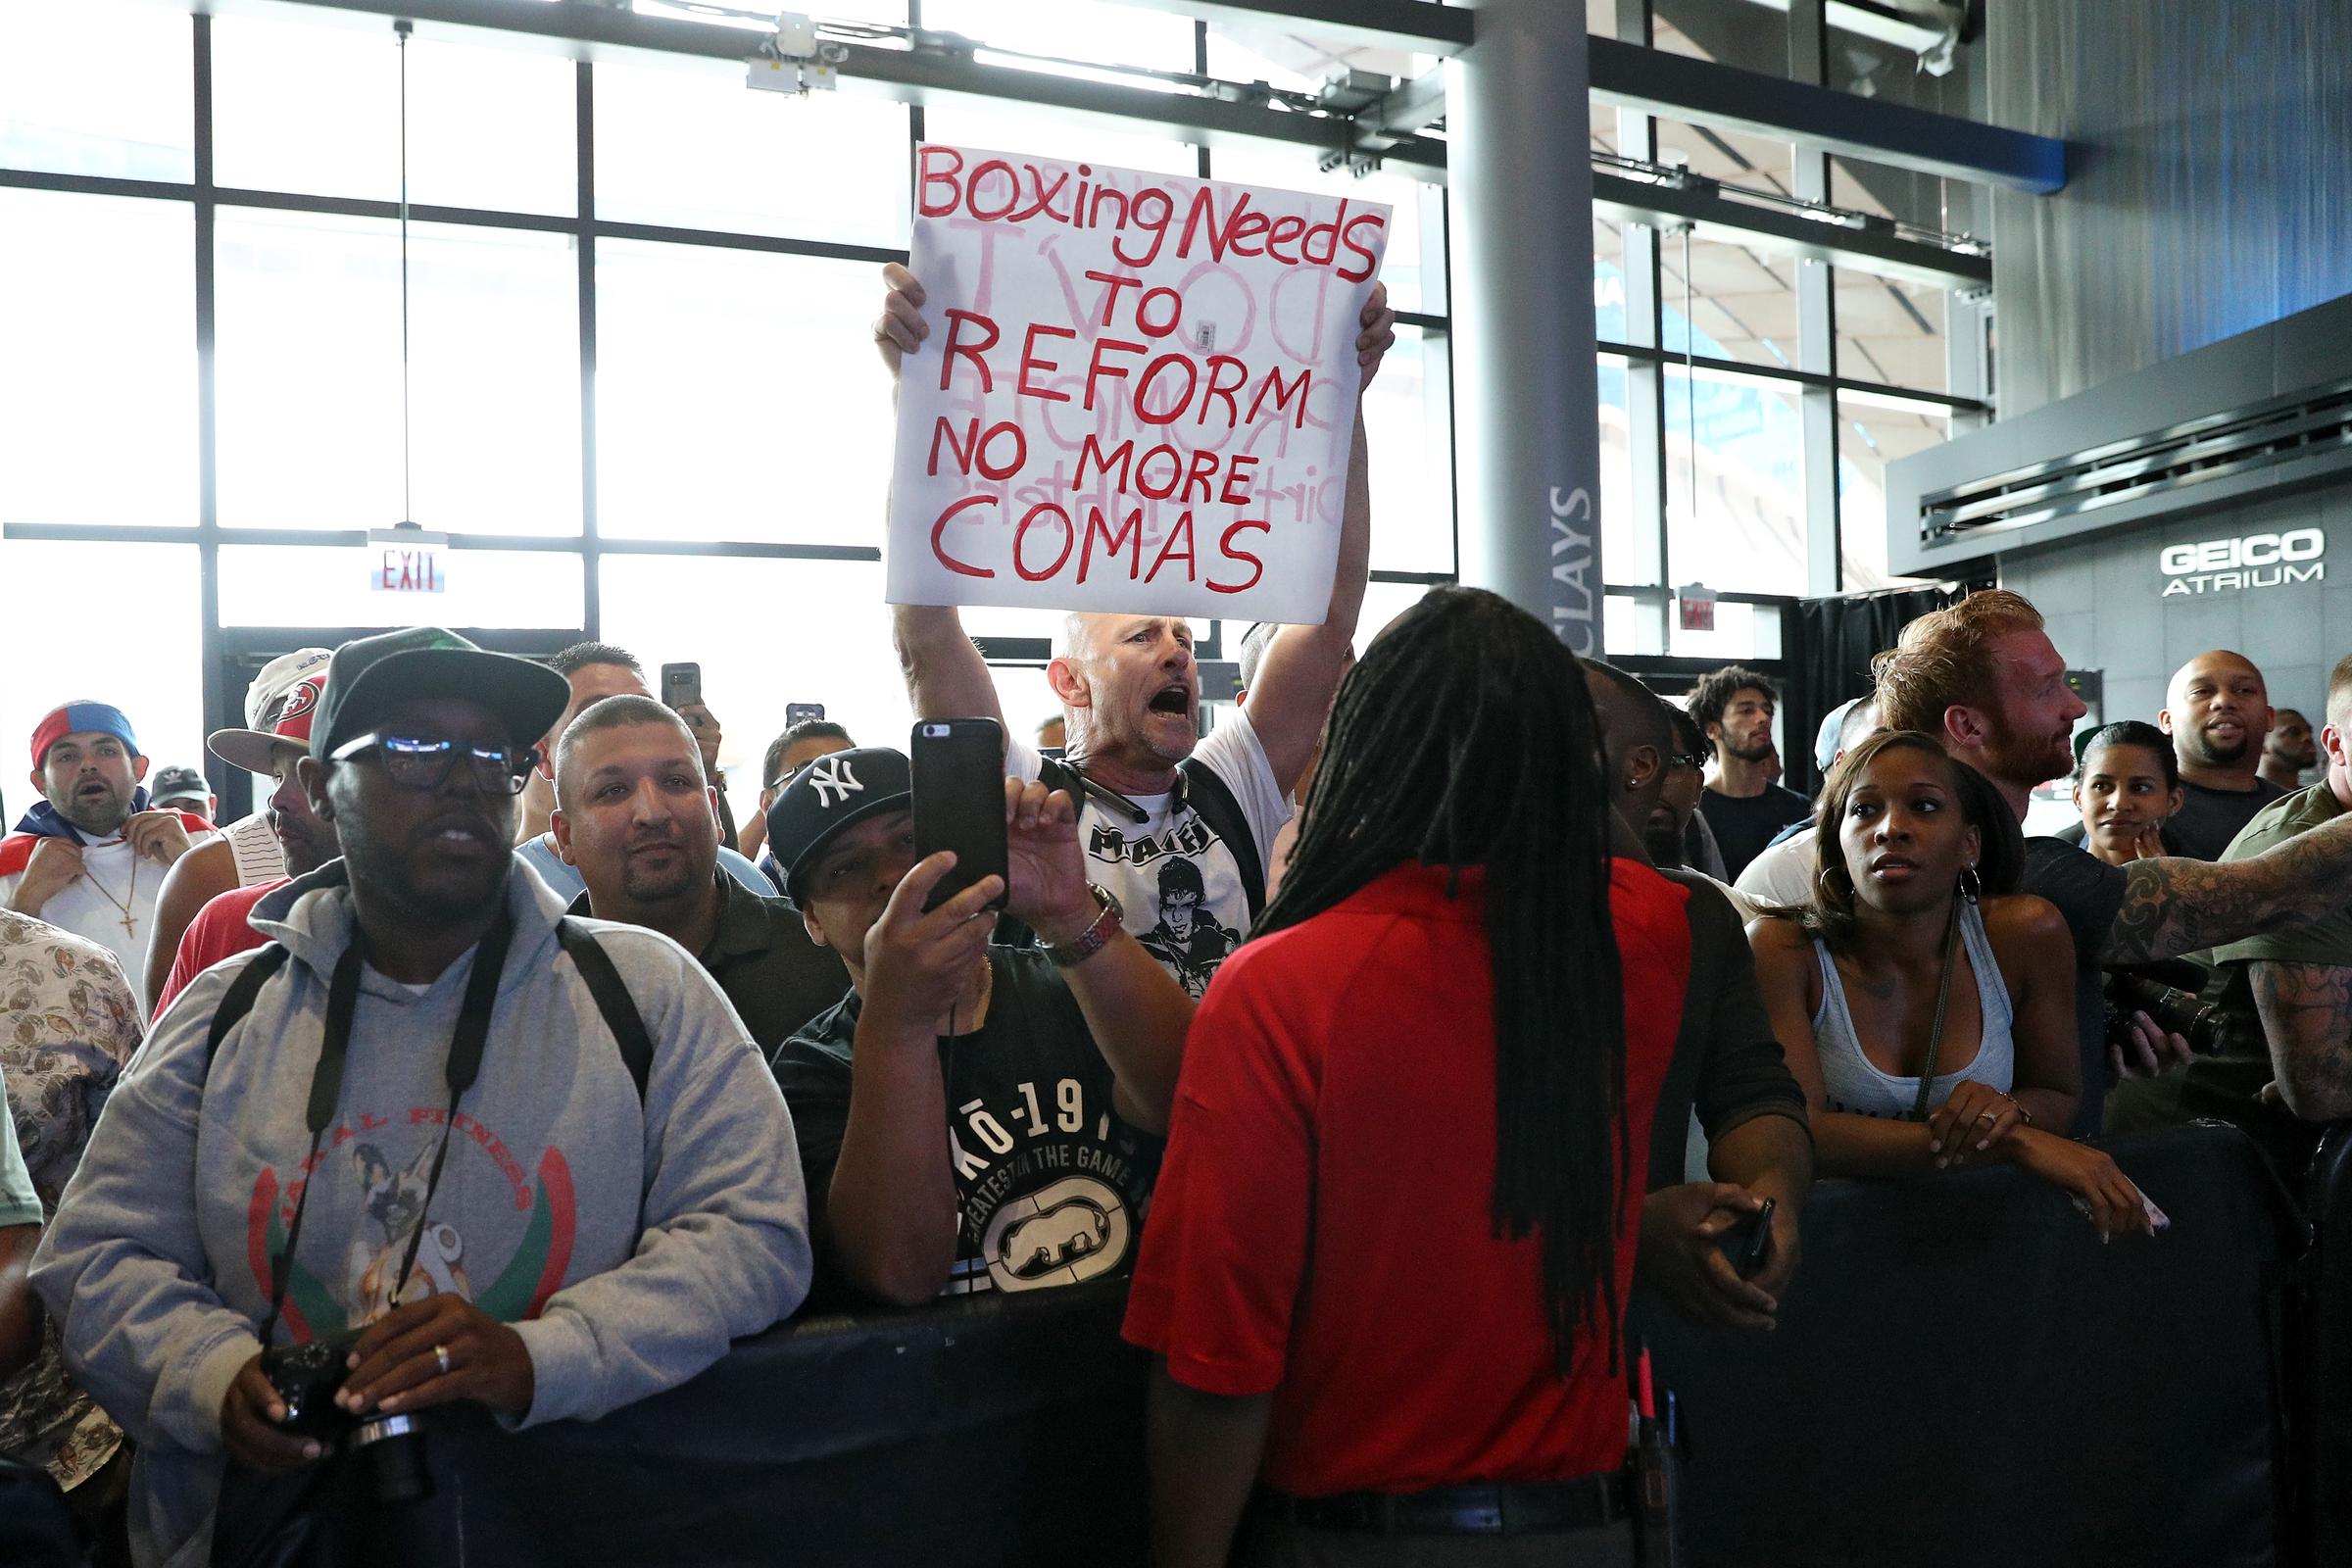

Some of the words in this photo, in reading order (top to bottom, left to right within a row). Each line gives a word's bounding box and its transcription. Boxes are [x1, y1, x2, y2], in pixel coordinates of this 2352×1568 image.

[1176, 186, 1385, 282] Needs
[940, 308, 1311, 428] REFORM
[927, 416, 1027, 480] NO
[1072, 434, 1259, 506] MORE
[931, 495, 1271, 594] COMAS
[2160, 527, 2326, 576] GEICO
[383, 550, 436, 590] EXIT
[2161, 562, 2325, 598] ATRIUM
[809, 758, 863, 808] NY
[1033, 1144, 1070, 1170] THE
[1077, 1146, 1132, 1188] GAME
